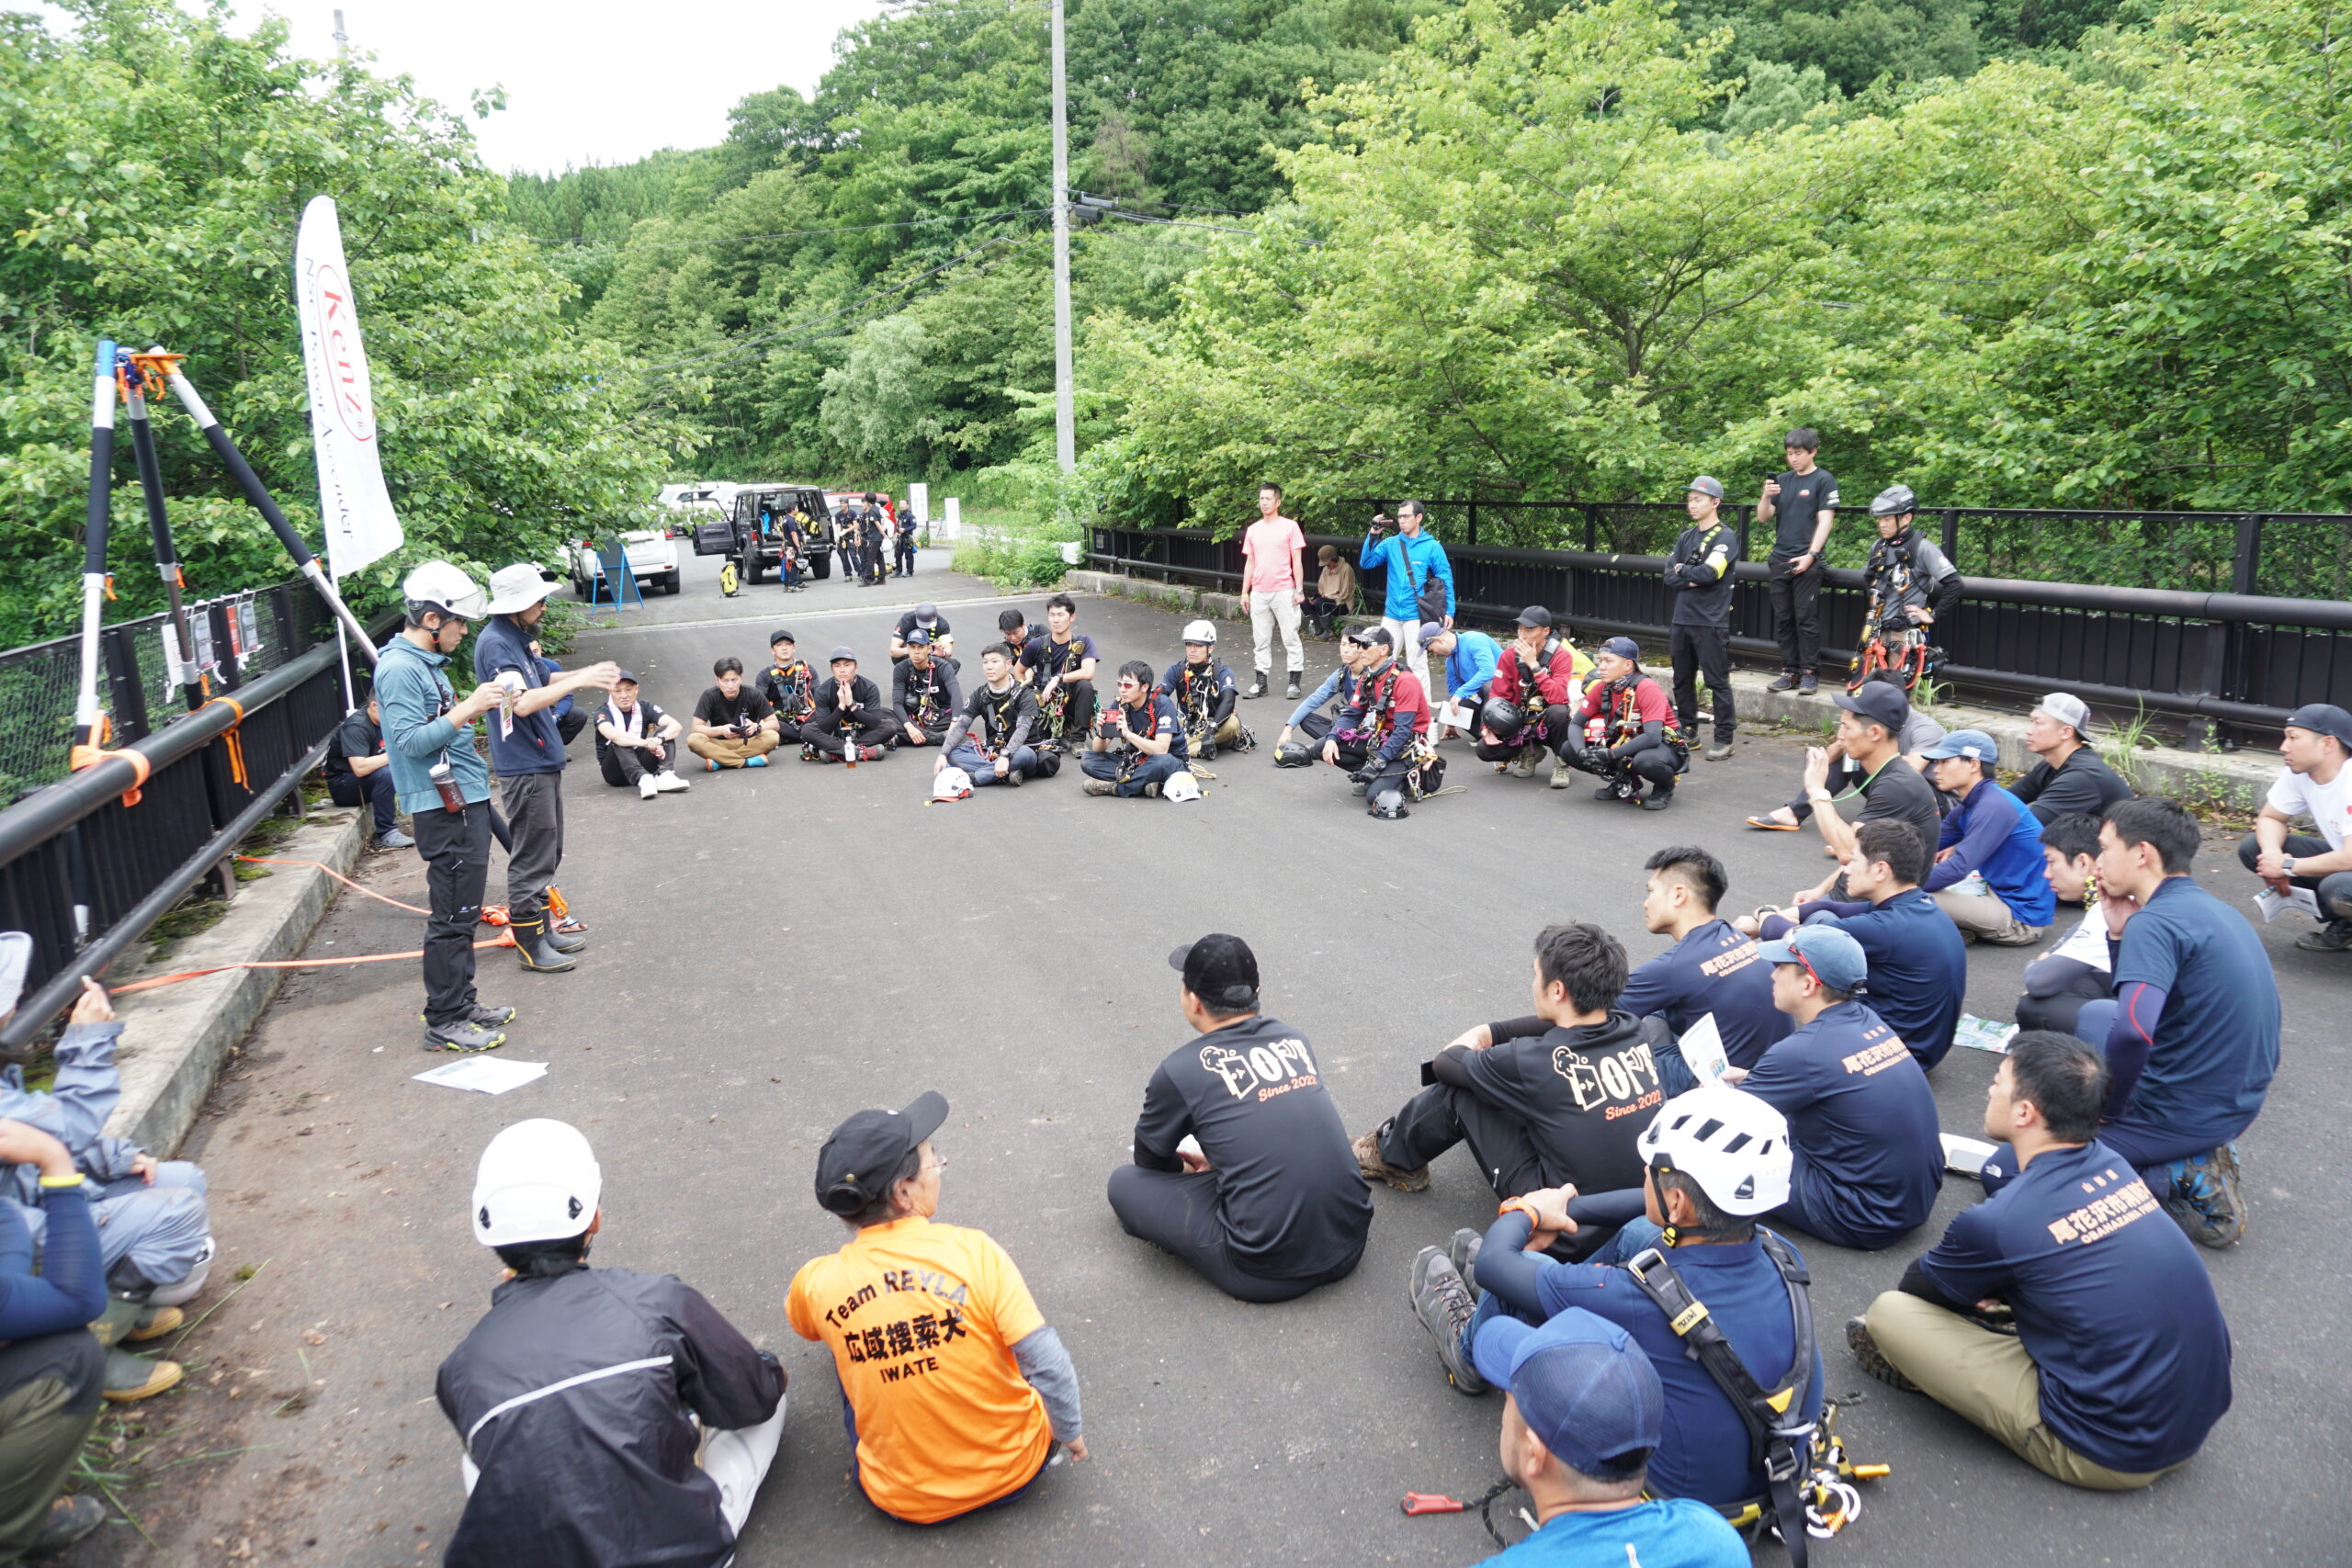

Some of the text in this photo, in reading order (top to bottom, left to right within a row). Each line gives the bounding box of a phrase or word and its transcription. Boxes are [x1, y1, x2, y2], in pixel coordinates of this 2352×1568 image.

[323, 288, 363, 414] Kenz
[1258, 1075, 1319, 1102] Since 2022
[1605, 1089, 1663, 1121] Since 2022
[825, 1269, 968, 1329] Team REYLA
[843, 1307, 967, 1364] 広域捜索犬
[879, 1356, 940, 1384] IWATE
